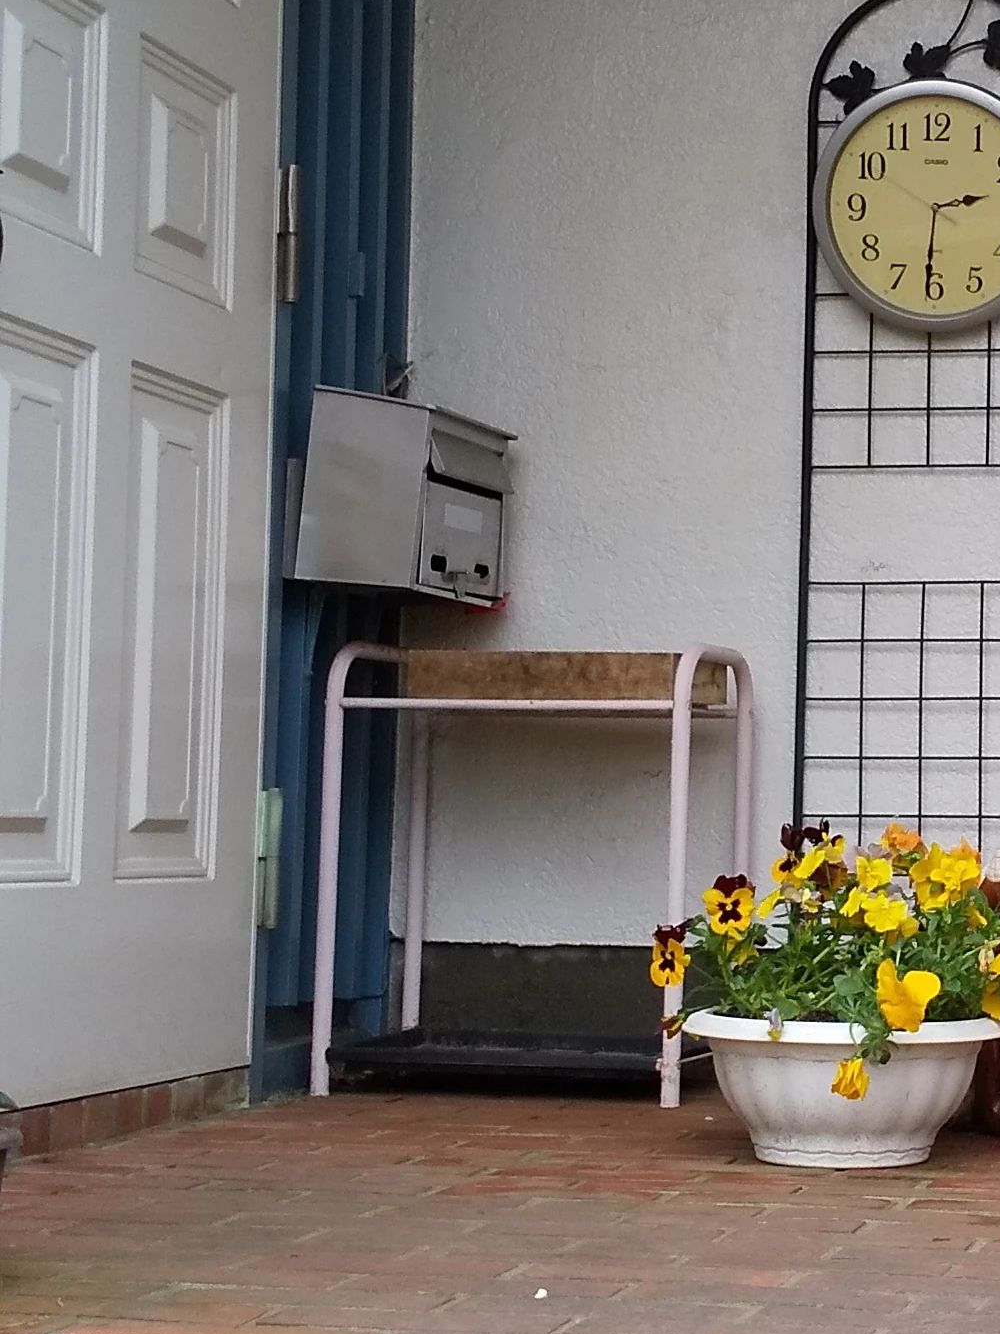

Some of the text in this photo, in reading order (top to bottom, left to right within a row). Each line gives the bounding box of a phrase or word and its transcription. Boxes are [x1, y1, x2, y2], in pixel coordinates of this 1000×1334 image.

[886, 122, 911, 151] 11
[922, 112, 952, 142] 12
[973, 123, 984, 153] 1
[857, 151, 887, 181] 10
[847, 192, 867, 222] 9
[861, 233, 881, 262] 8
[889, 263, 908, 291] 7
[926, 272, 945, 301] 6
[965, 266, 984, 294] 5
